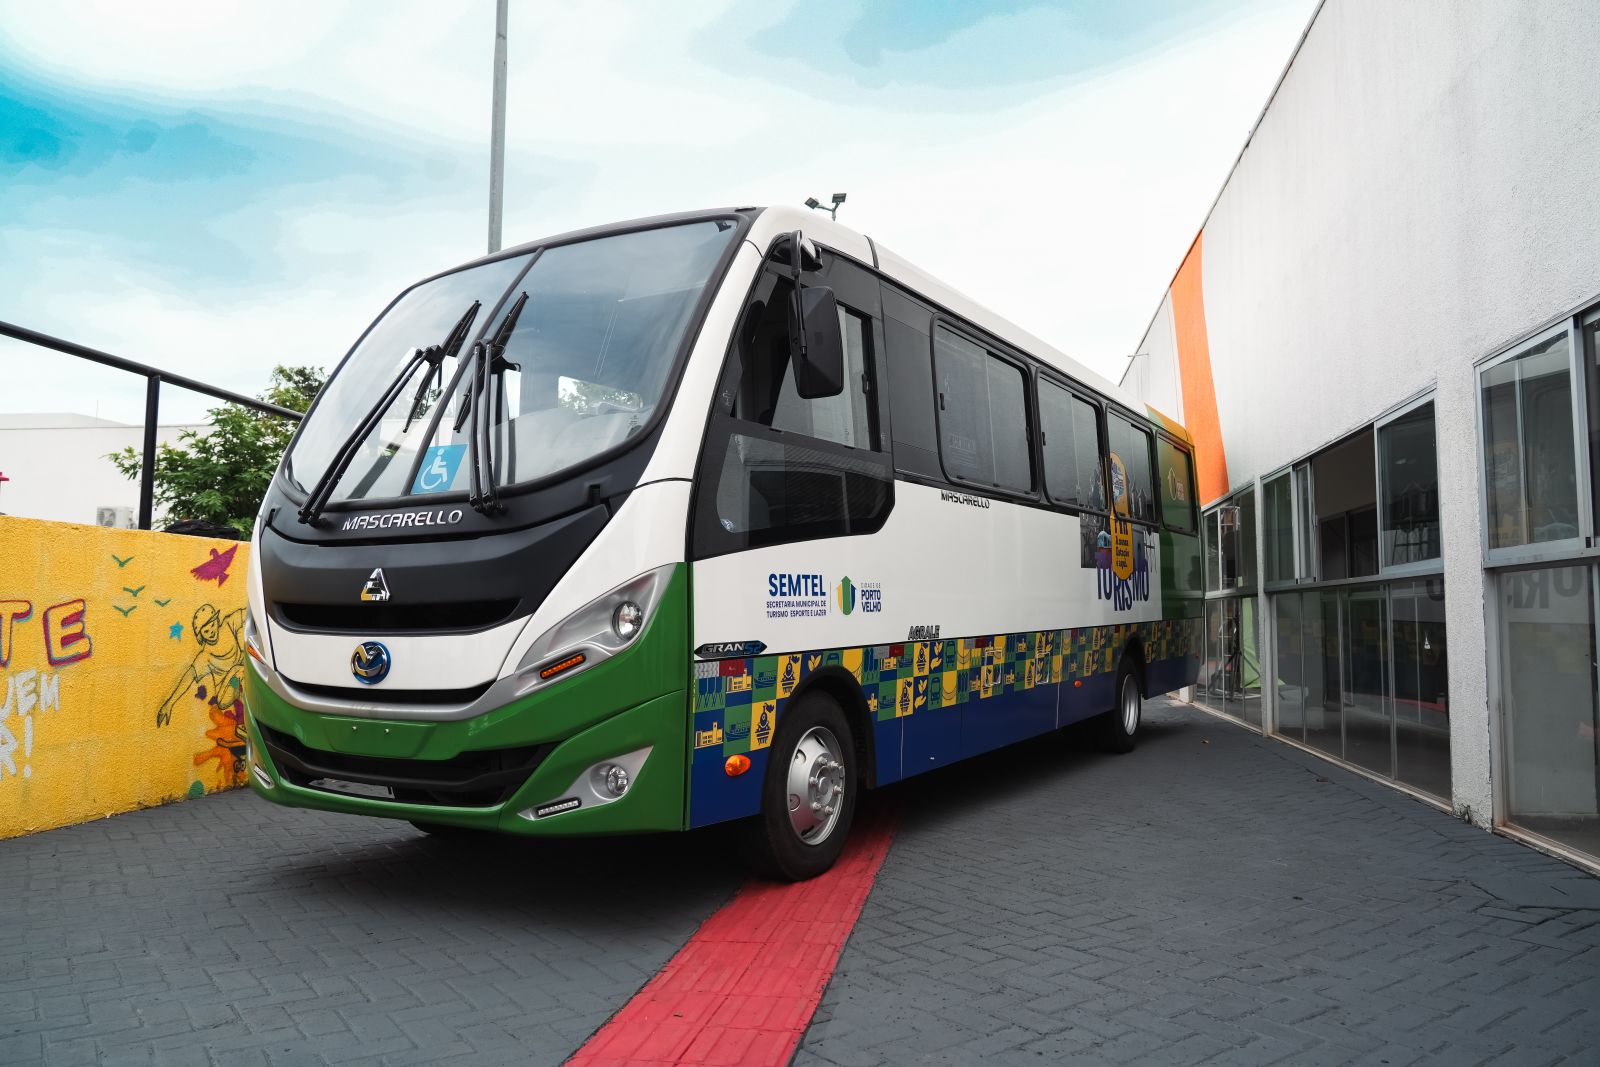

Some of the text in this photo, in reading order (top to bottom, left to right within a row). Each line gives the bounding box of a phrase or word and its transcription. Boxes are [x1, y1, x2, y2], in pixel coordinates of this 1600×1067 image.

[941, 489, 990, 509] MASCARELLO
[342, 509, 463, 531] MASCARELLO
[768, 573, 827, 597] SEMTEL
[861, 590, 881, 600] PORTO
[814, 609, 827, 617] LAZER
[861, 602, 881, 612] VELHO
[907, 624, 941, 640] AGRALE
[702, 643, 744, 653] GRAN
